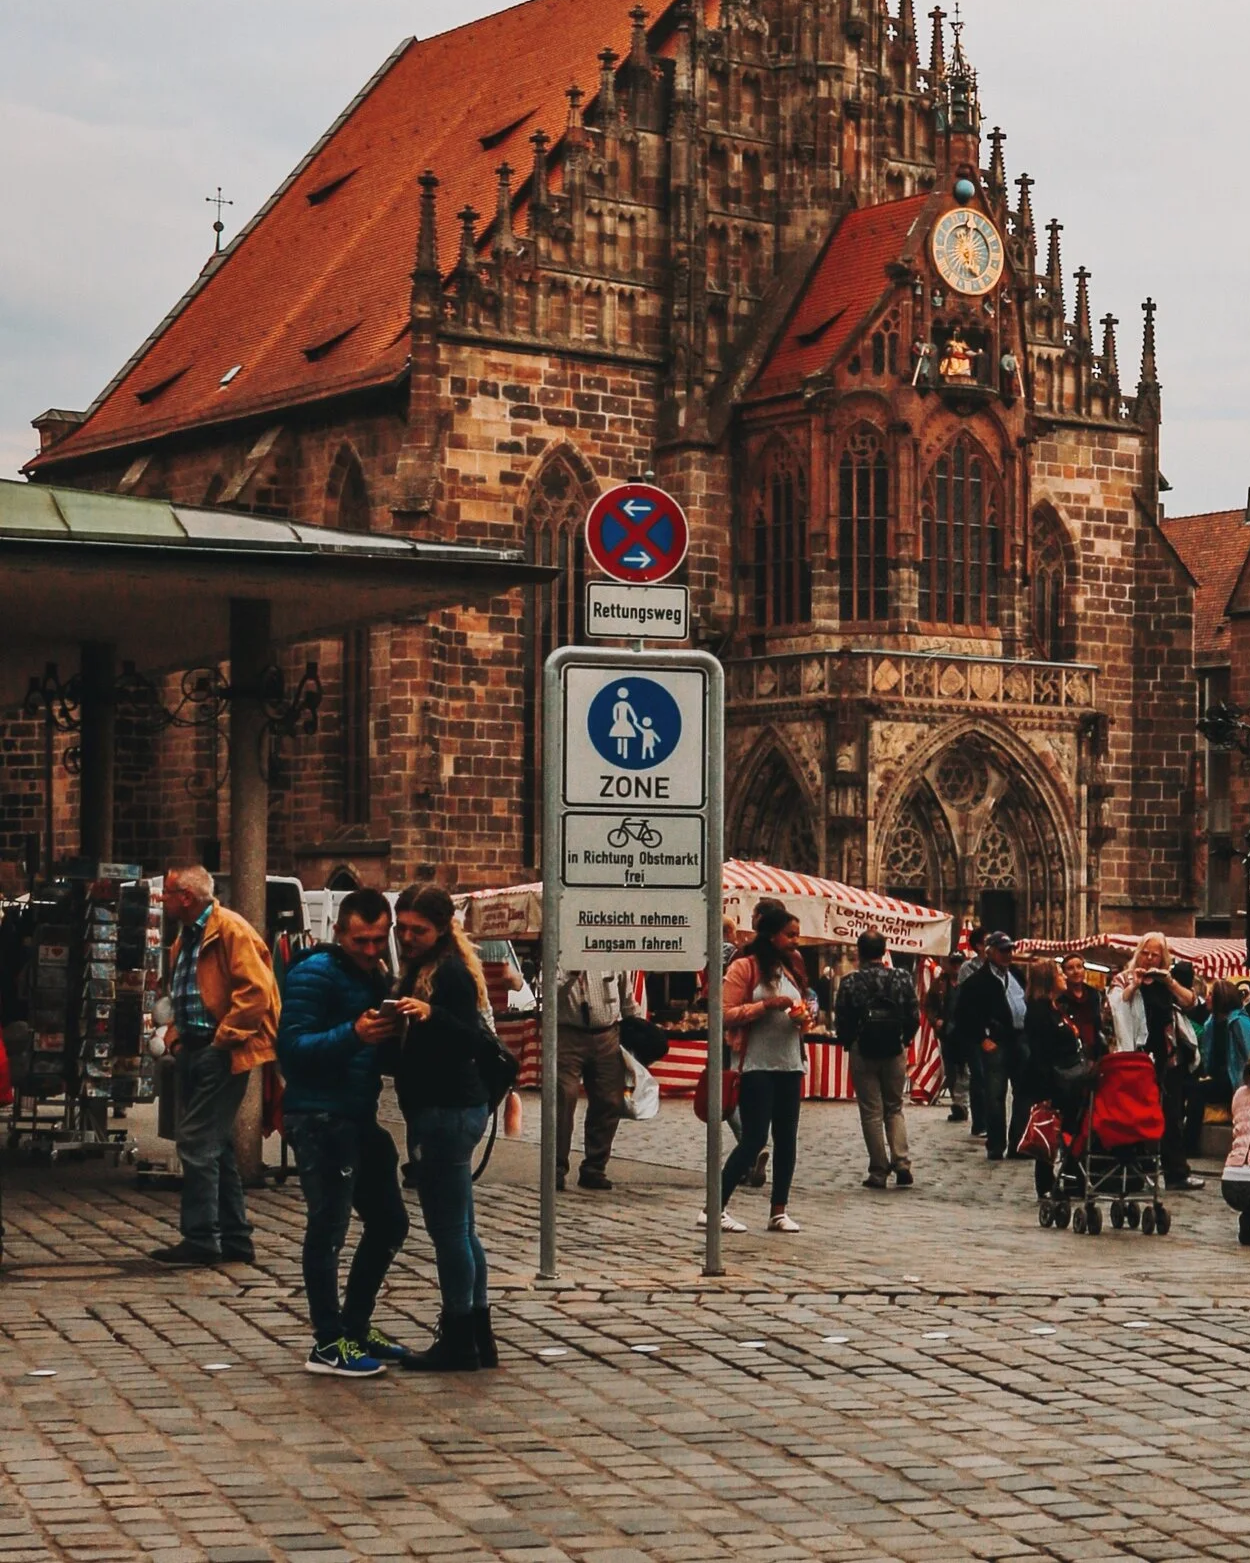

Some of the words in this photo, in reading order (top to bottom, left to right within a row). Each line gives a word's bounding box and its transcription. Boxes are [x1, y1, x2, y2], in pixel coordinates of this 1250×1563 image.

[593, 601, 682, 625] Rettungsweg
[600, 775, 670, 799] ZONE
[567, 850, 578, 864] in
[584, 850, 634, 868] Richtung
[639, 851, 699, 866] Obstmarkt
[624, 869, 645, 883] frei
[578, 910, 635, 924] Rücksicht
[640, 911, 688, 925] nehmen:
[836, 906, 925, 929] Lebkuchen
[846, 919, 878, 931] ohne
[882, 923, 911, 936] Mehl
[585, 935, 636, 952] Langsam
[642, 936, 682, 950] fahren!
[833, 926, 923, 948] Glunfrei
